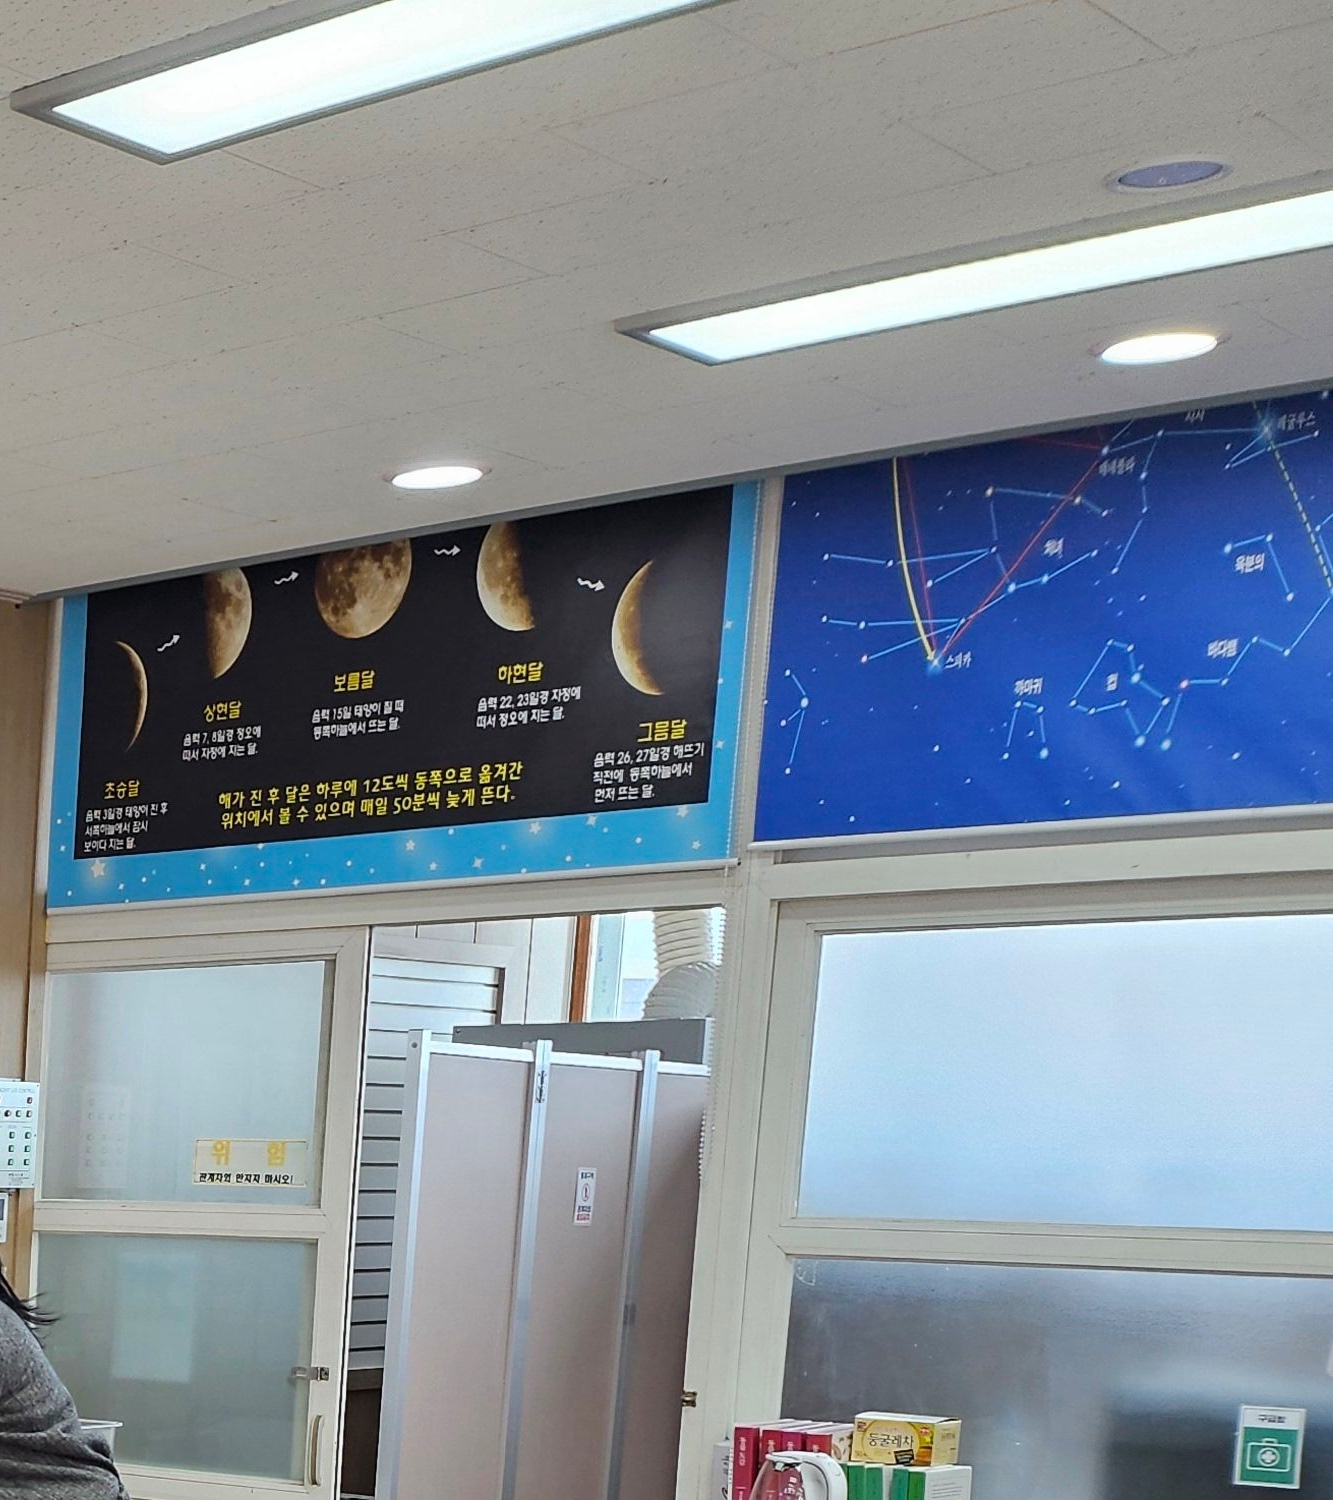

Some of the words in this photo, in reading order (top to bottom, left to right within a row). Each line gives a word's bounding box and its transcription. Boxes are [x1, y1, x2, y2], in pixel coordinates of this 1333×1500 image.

[334, 670, 375, 693] 보름달
[498, 661, 544, 685] 하현달
[477, 697, 498, 713] 음력
[499, 694, 515, 709] 22,
[517, 690, 549, 707] 23일경
[551, 686, 581, 702] 자정에
[203, 700, 242, 723] 상현달
[476, 714, 496, 730] 떠서
[498, 711, 528, 728] 정오에
[530, 708, 550, 724] 지는
[552, 705, 564, 721] 달.
[637, 719, 687, 743] 그믐달
[594, 752, 615, 768] 음력
[617, 750, 633, 765] 26,
[635, 745, 670, 763] 27일경
[673, 742, 704, 759] 해뜨기
[218, 791, 246, 809] 해가
[250, 790, 263, 808] 진
[267, 787, 280, 804] 후
[285, 784, 311, 804] 달은
[316, 778, 357, 800] 하루에
[363, 772, 408, 795] 12도씩
[414, 765, 473, 789] 동쪽으로
[478, 760, 523, 782] 옮겨간
[593, 768, 623, 785] 직전에
[104, 780, 140, 800] 초승달
[594, 787, 615, 803] 먼저
[617, 785, 639, 801] 뜨는
[641, 783, 654, 799] 달.
[221, 810, 273, 830] 위치에서
[279, 807, 291, 824] 볼
[296, 805, 310, 823] 수
[314, 800, 356, 822] 있으며
[360, 796, 388, 817] 매일
[393, 790, 440, 815] 50분씩
[446, 788, 475, 808] 늦게
[480, 784, 516, 805] 뜬다.
[199, 1172, 231, 1183] 관계자외
[236, 1173, 261, 1184] 만지지
[265, 1174, 293, 1185] 마시오!
[868, 1433, 914, 1448] 둥굴레차
